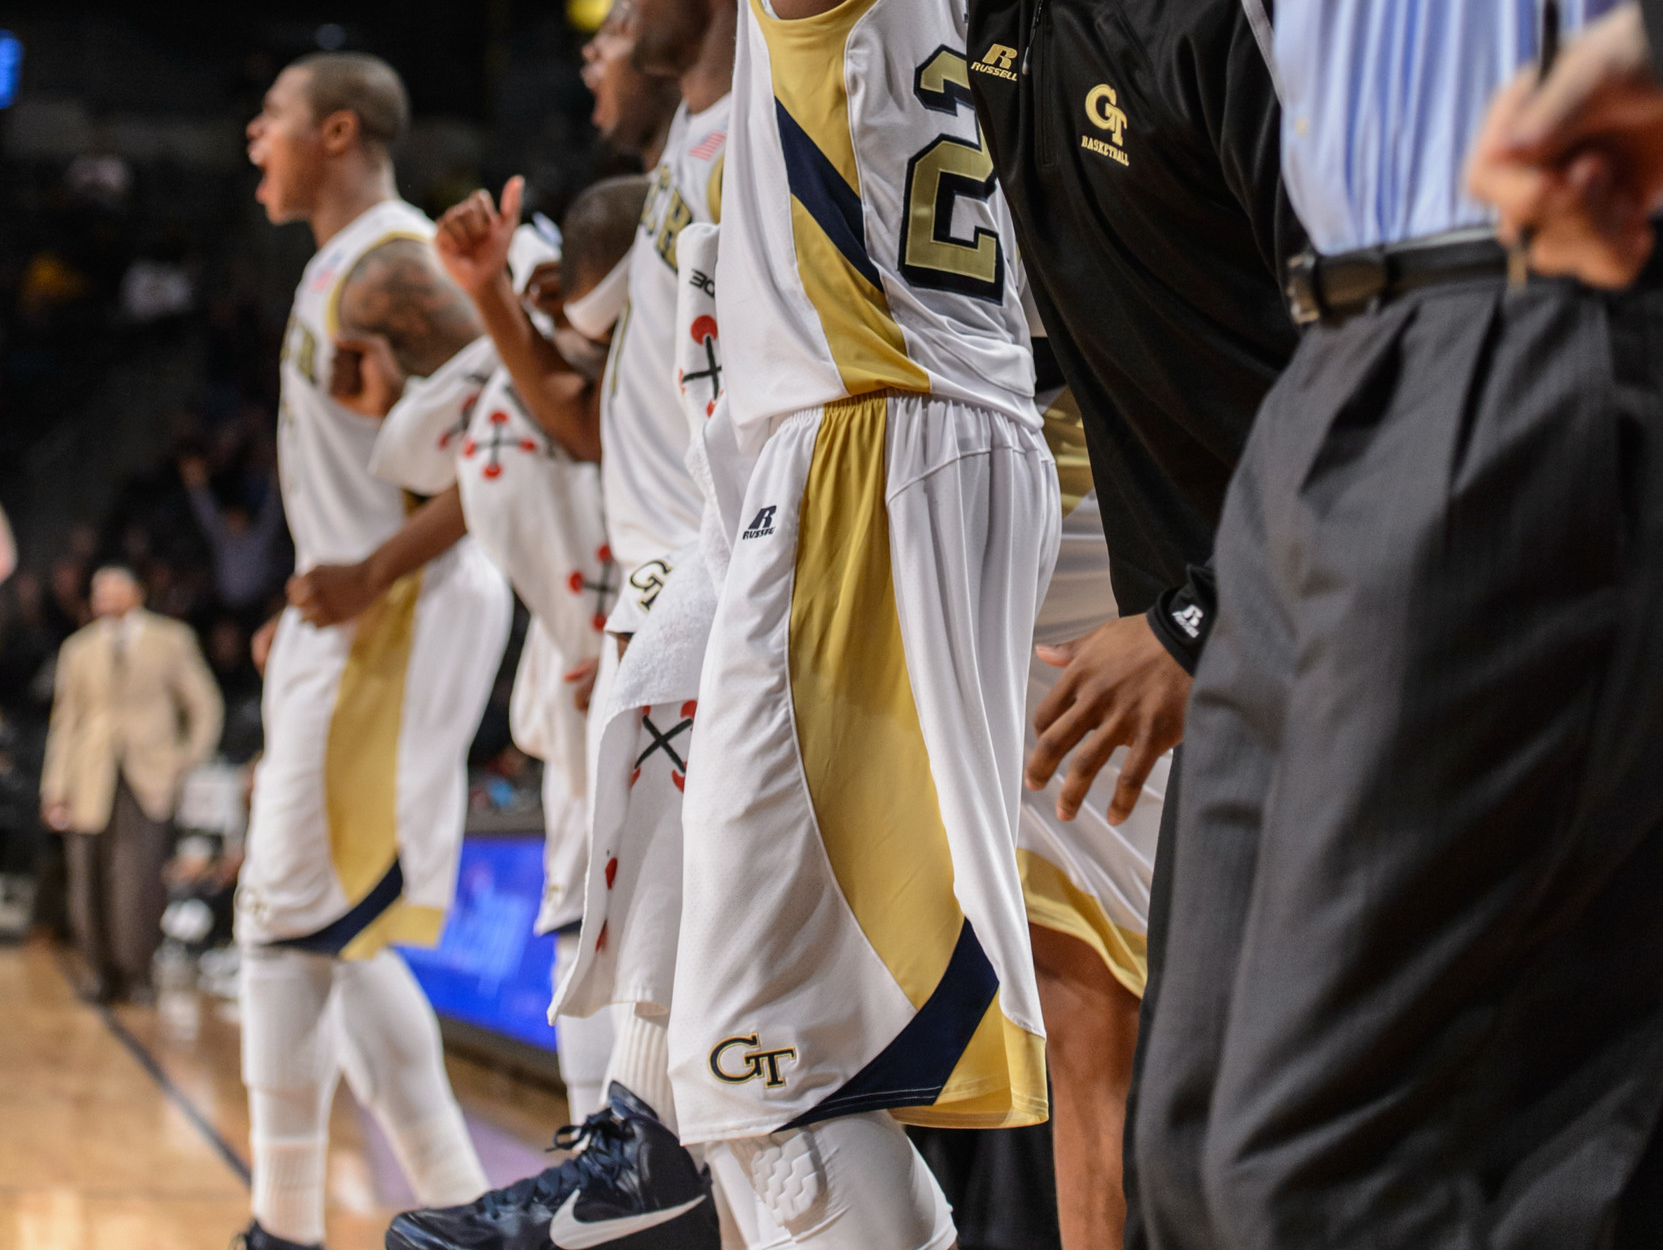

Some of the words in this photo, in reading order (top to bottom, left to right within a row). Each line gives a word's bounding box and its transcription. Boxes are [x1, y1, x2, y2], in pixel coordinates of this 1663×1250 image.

[982, 43, 1018, 69] R
[971, 61, 1018, 81] RUSSELL
[1085, 84, 1128, 146] GT
[1081, 136, 1129, 166] BASKETBALL
[748, 505, 777, 529] R
[708, 1033, 796, 1088] GT
